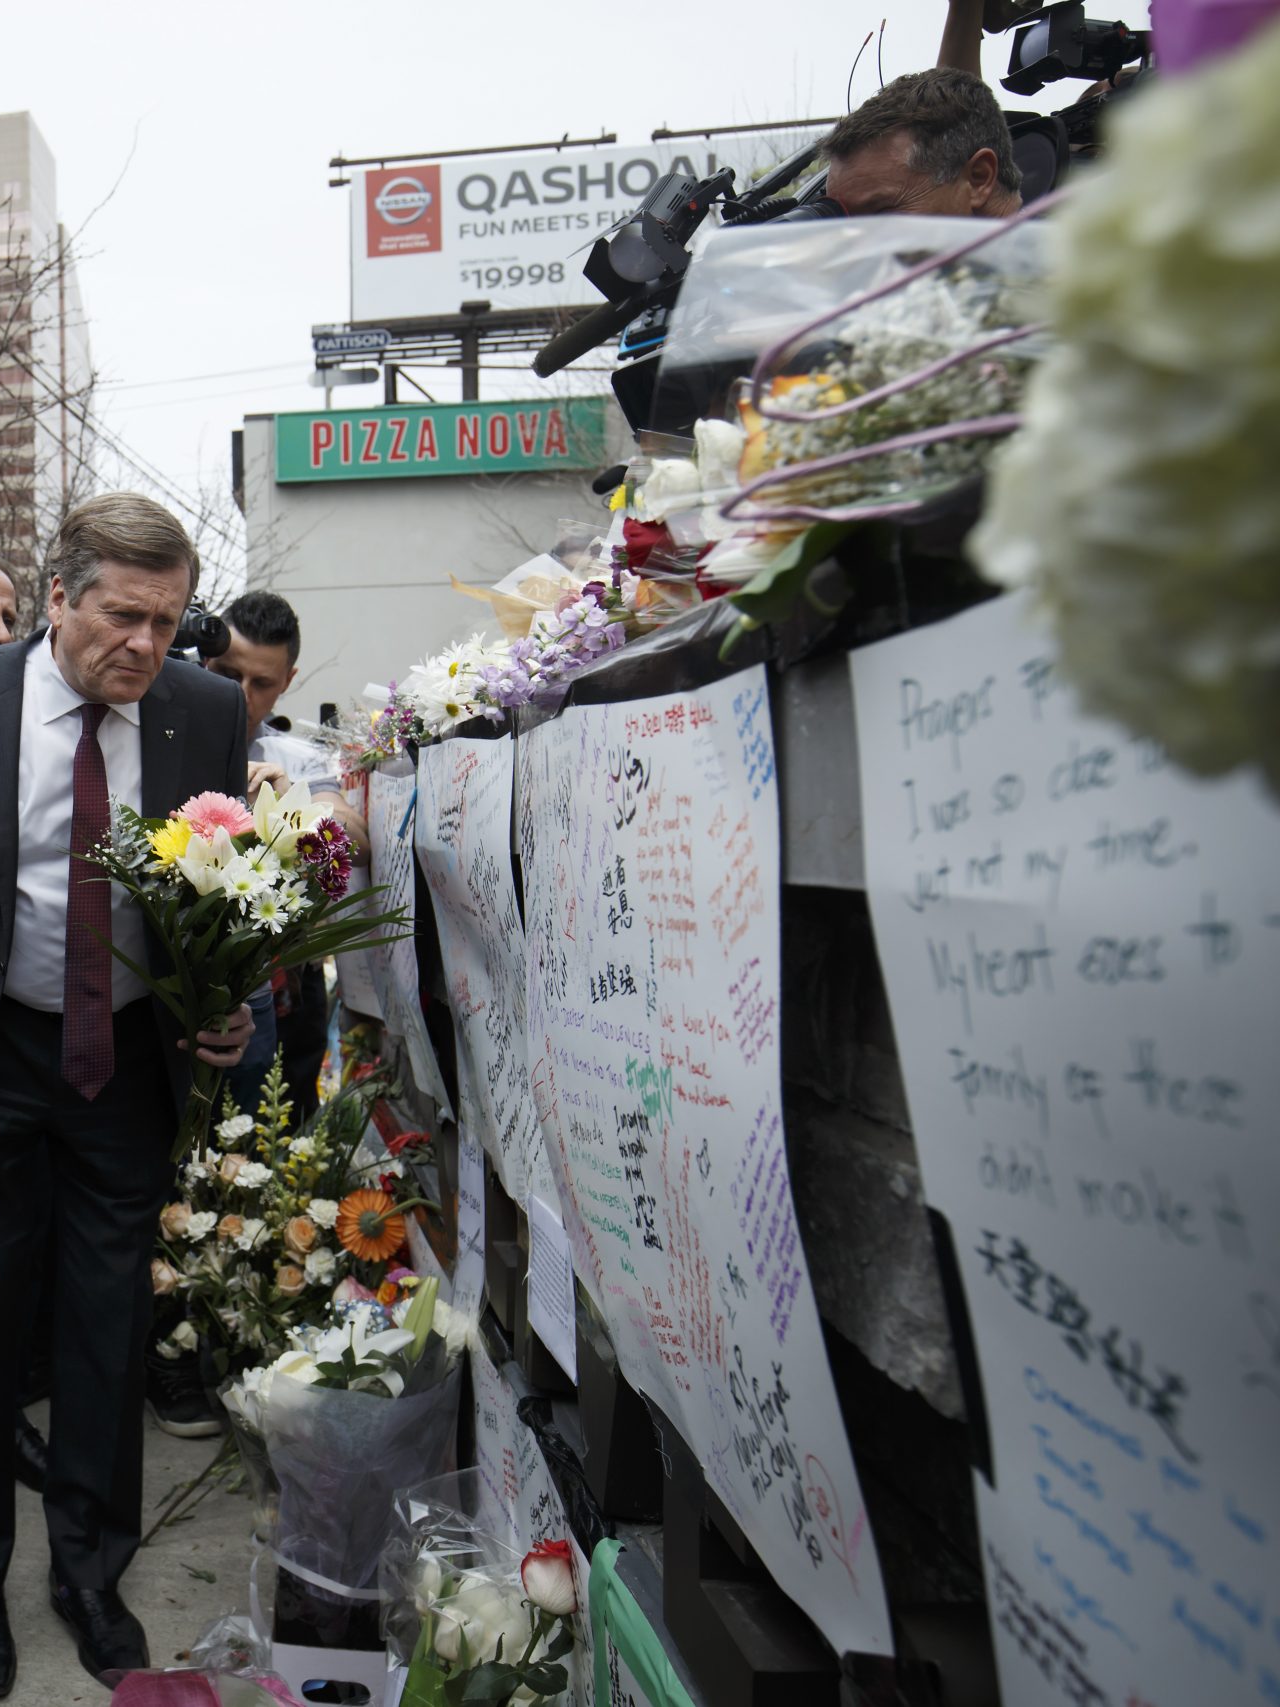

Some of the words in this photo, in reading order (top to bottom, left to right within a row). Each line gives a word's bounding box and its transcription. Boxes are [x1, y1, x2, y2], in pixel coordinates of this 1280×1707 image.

[459, 221, 505, 239] FUN
[511, 213, 590, 235] MEETS
[461, 262, 565, 290] $19,998
[317, 333, 386, 350] PATTISON
[310, 416, 440, 469] PIZZA
[455, 407, 570, 460] NOVA
[900, 778, 922, 841] I
[929, 789, 971, 833] was
[993, 774, 1024, 815] so
[966, 840, 1003, 889] not
[1025, 843, 1068, 917] my
[589, 960, 638, 1004] 生者坚强
[682, 1001, 706, 1036] Love
